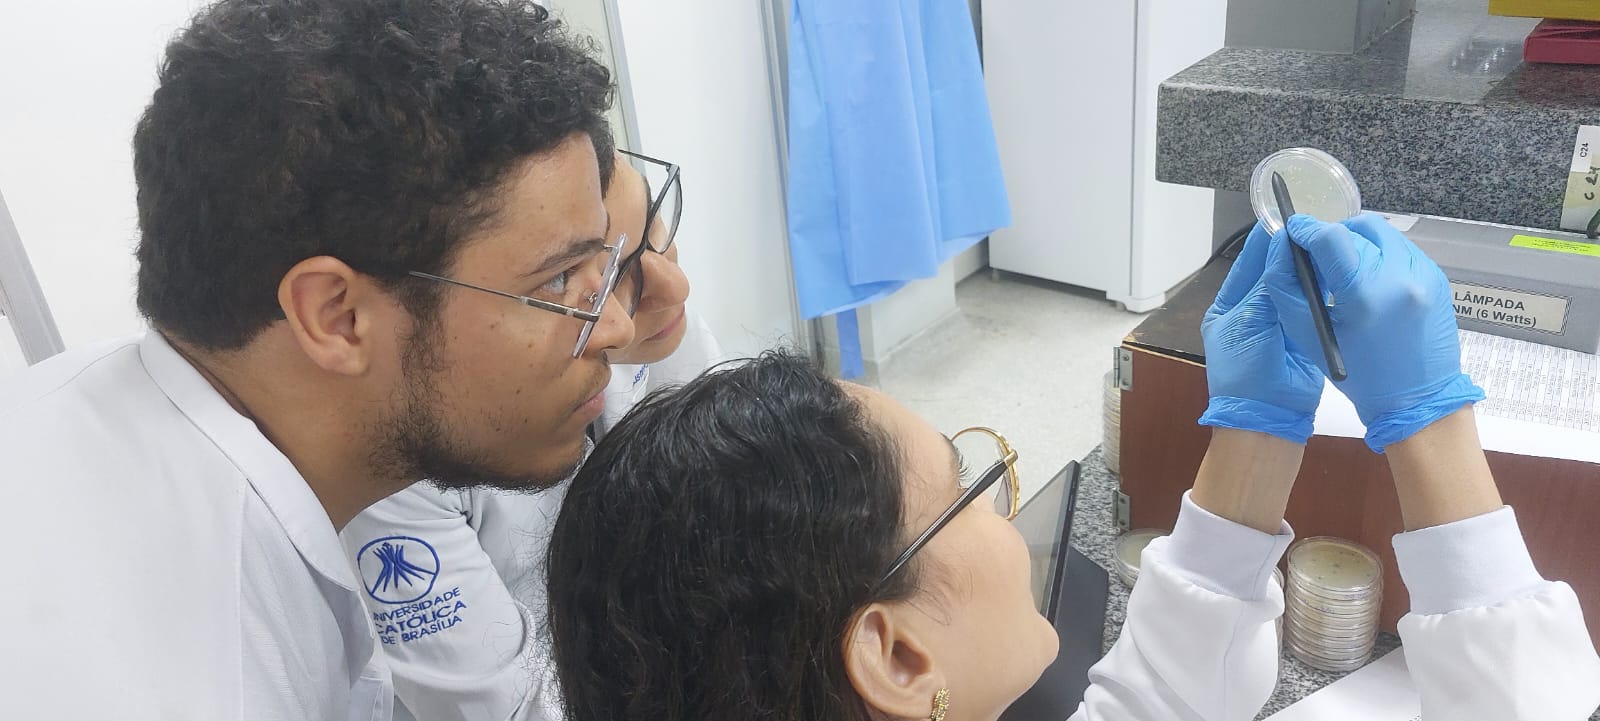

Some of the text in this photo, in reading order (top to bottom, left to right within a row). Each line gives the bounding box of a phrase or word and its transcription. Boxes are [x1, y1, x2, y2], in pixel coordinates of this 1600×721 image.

[1580, 143, 1589, 158] C24
[1454, 291, 1525, 311] LÂMPADA
[1476, 307, 1489, 321] (6
[1493, 310, 1537, 328] Watts)
[380, 615, 462, 645] DE BRASÍLIA
